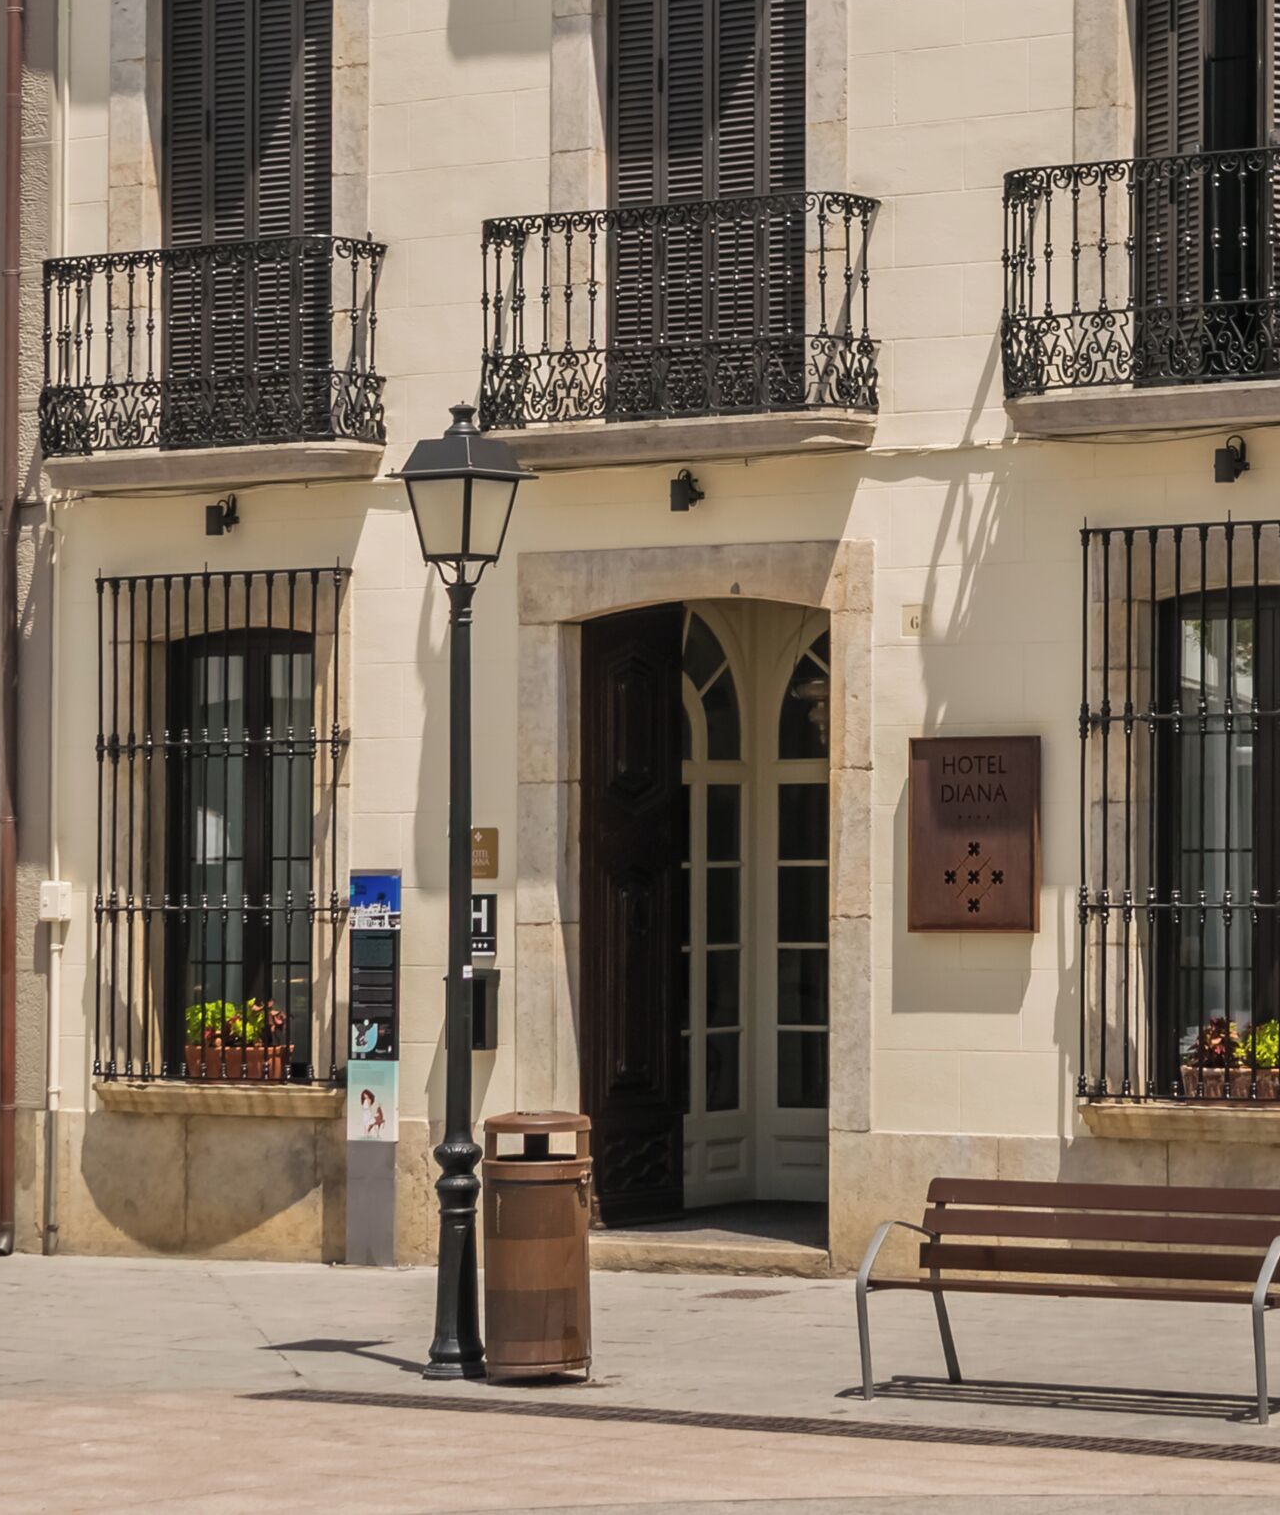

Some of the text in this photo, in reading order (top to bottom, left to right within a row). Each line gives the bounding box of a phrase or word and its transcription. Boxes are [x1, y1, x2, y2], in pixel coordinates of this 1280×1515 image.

[910, 615, 919, 630] 6
[942, 756, 1007, 774] HOTEL
[941, 784, 1007, 803] DIANA
[471, 899, 488, 932] H
